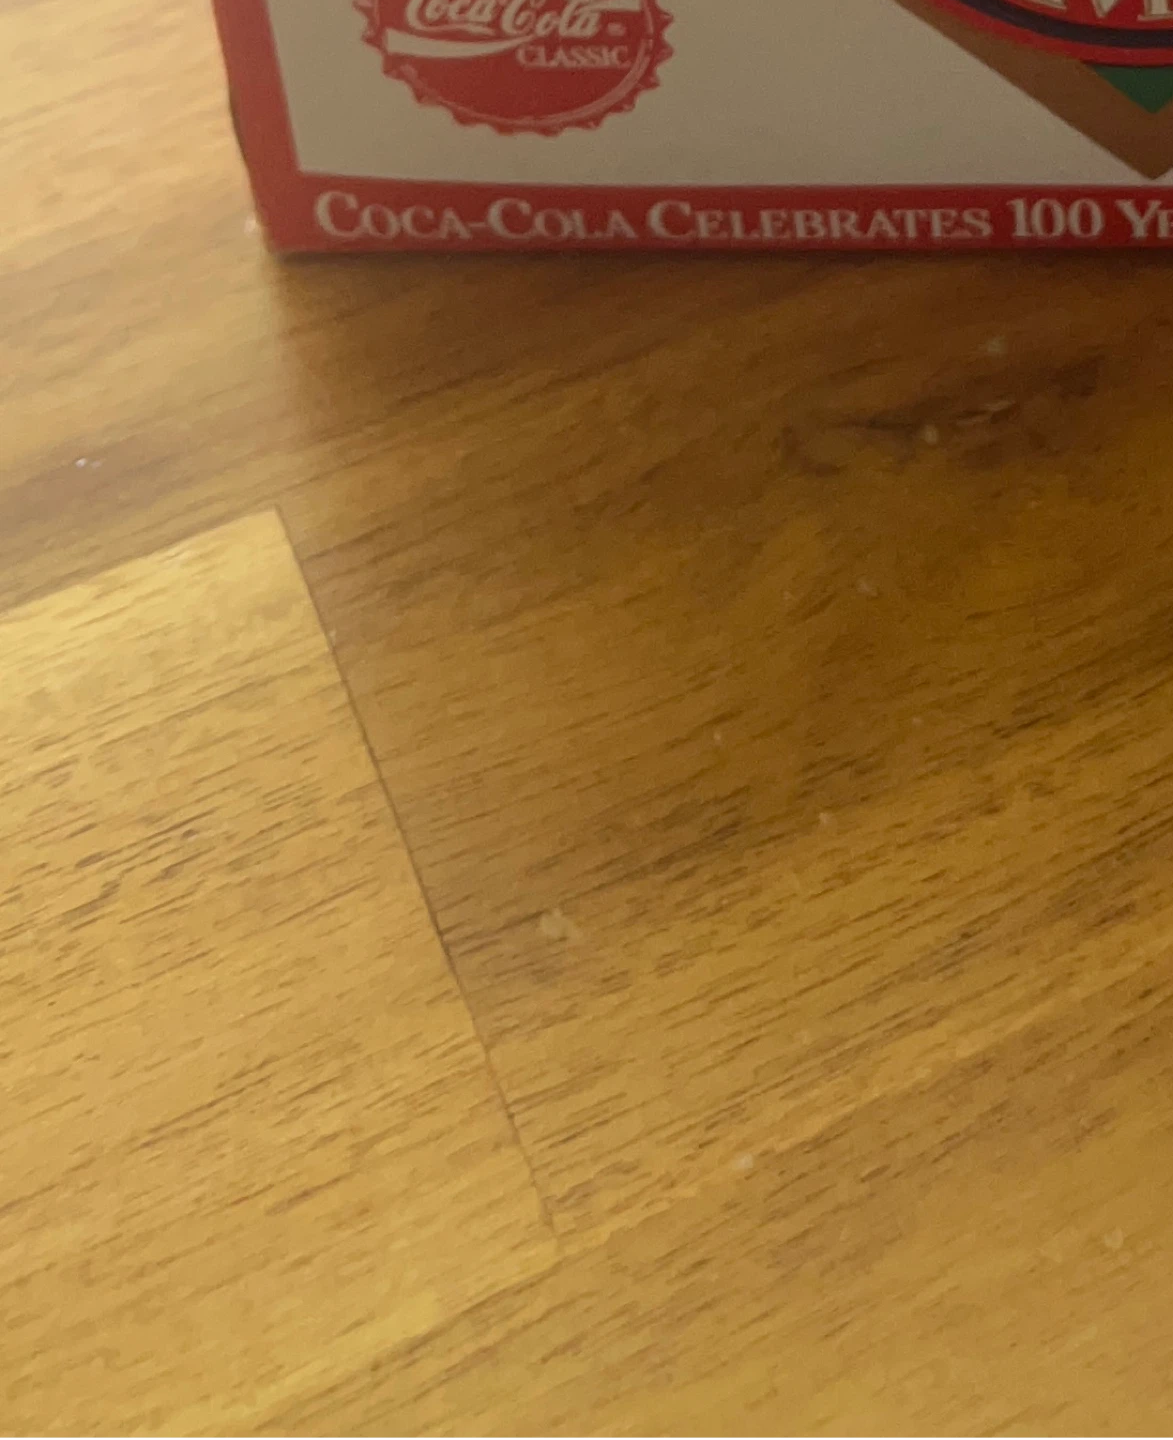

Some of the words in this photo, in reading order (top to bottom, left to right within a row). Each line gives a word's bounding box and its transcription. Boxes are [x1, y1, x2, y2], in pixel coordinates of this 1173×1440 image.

[515, 44, 631, 69] CLASSIC
[313, 190, 638, 241] COCA-COLA
[646, 199, 995, 241] CELEBRATES
[1005, 197, 1105, 240] 100
